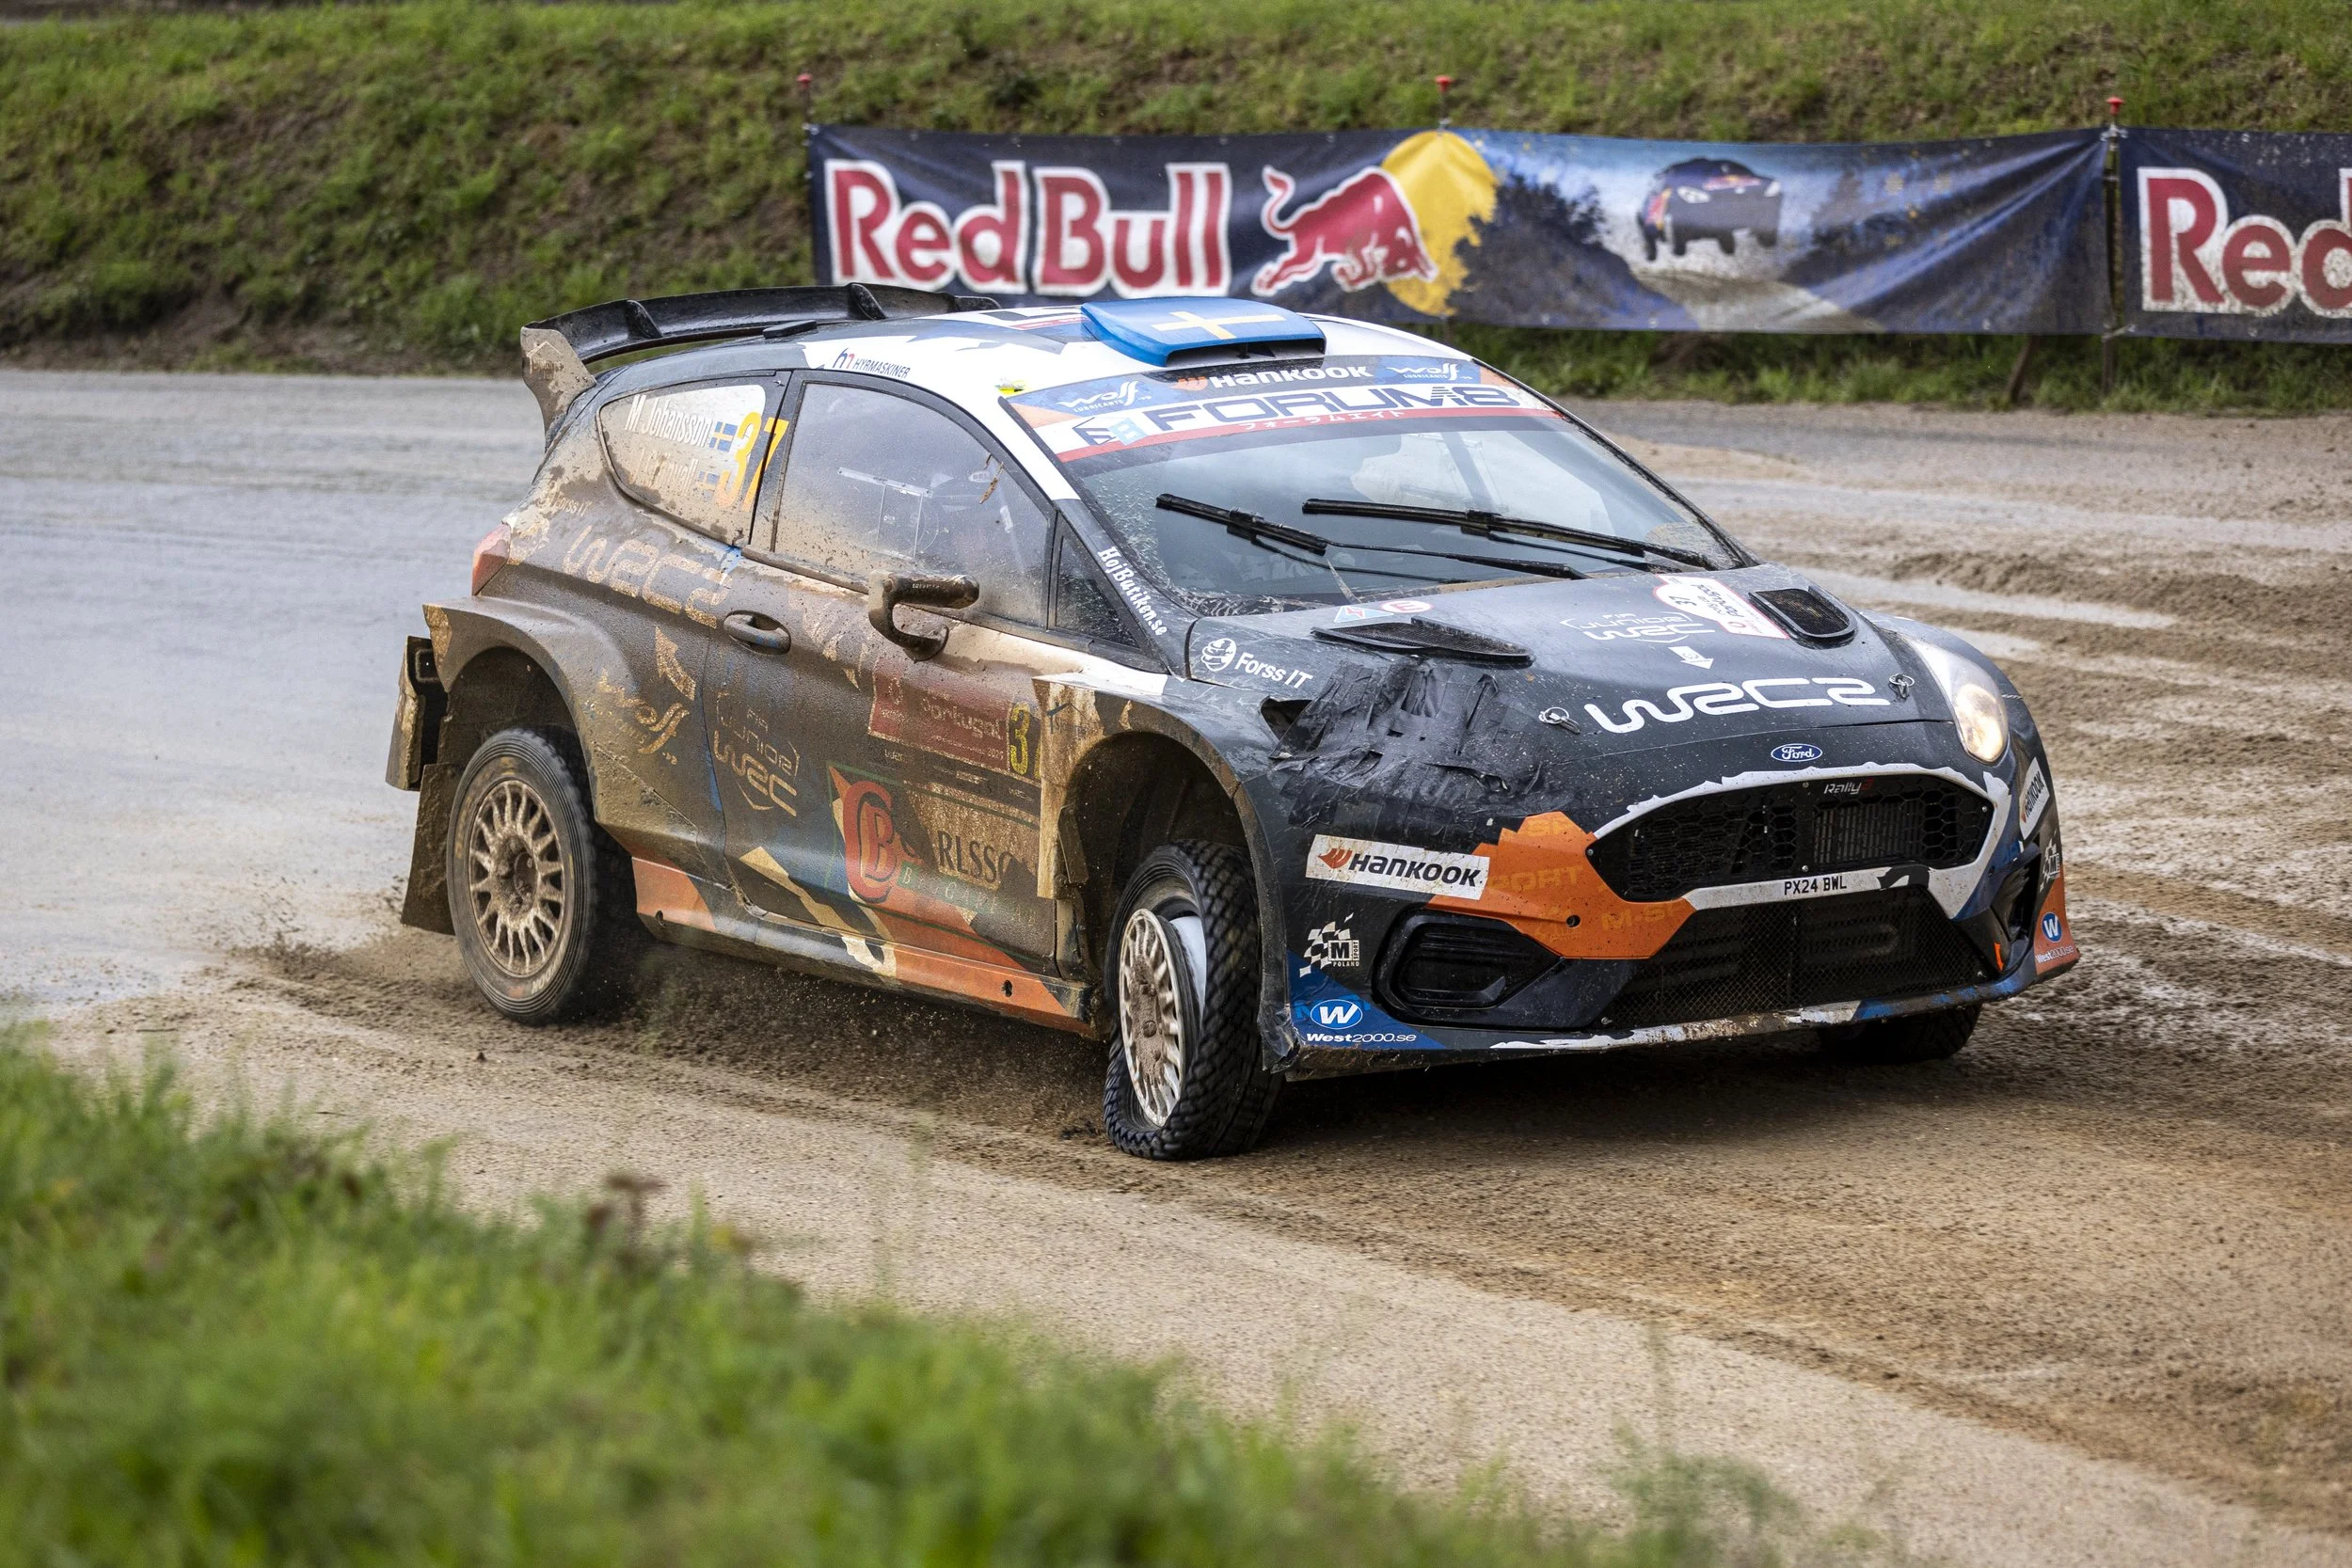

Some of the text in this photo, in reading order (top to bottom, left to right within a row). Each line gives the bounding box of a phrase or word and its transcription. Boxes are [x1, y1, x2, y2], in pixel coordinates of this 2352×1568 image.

[824, 160, 1232, 297] Red Bull
[852, 358, 911, 379] HYRMASKINER
[1210, 366, 1374, 388] HANKOOK
[1142, 386, 1520, 433] FORUM8
[1240, 410, 1404, 430] フォーラムエイト
[641, 397, 712, 448] Johansson
[713, 411, 789, 513] 37
[1579, 616, 1688, 629] JUNIOR
[1583, 623, 1716, 641] WRC
[1234, 652, 1314, 689] Forss IT
[1584, 677, 1891, 734] WRC2
[1009, 701, 1041, 779] 3
[1781, 746, 1815, 760] Ford
[713, 729, 798, 817] WRC
[1348, 852, 1481, 887] HANKOOK
[1784, 876, 1848, 895] PX24 BWL
[1330, 942, 1350, 959] M
[1319, 1003, 1359, 1024] W
[1306, 1033, 1417, 1043] West2000.se
